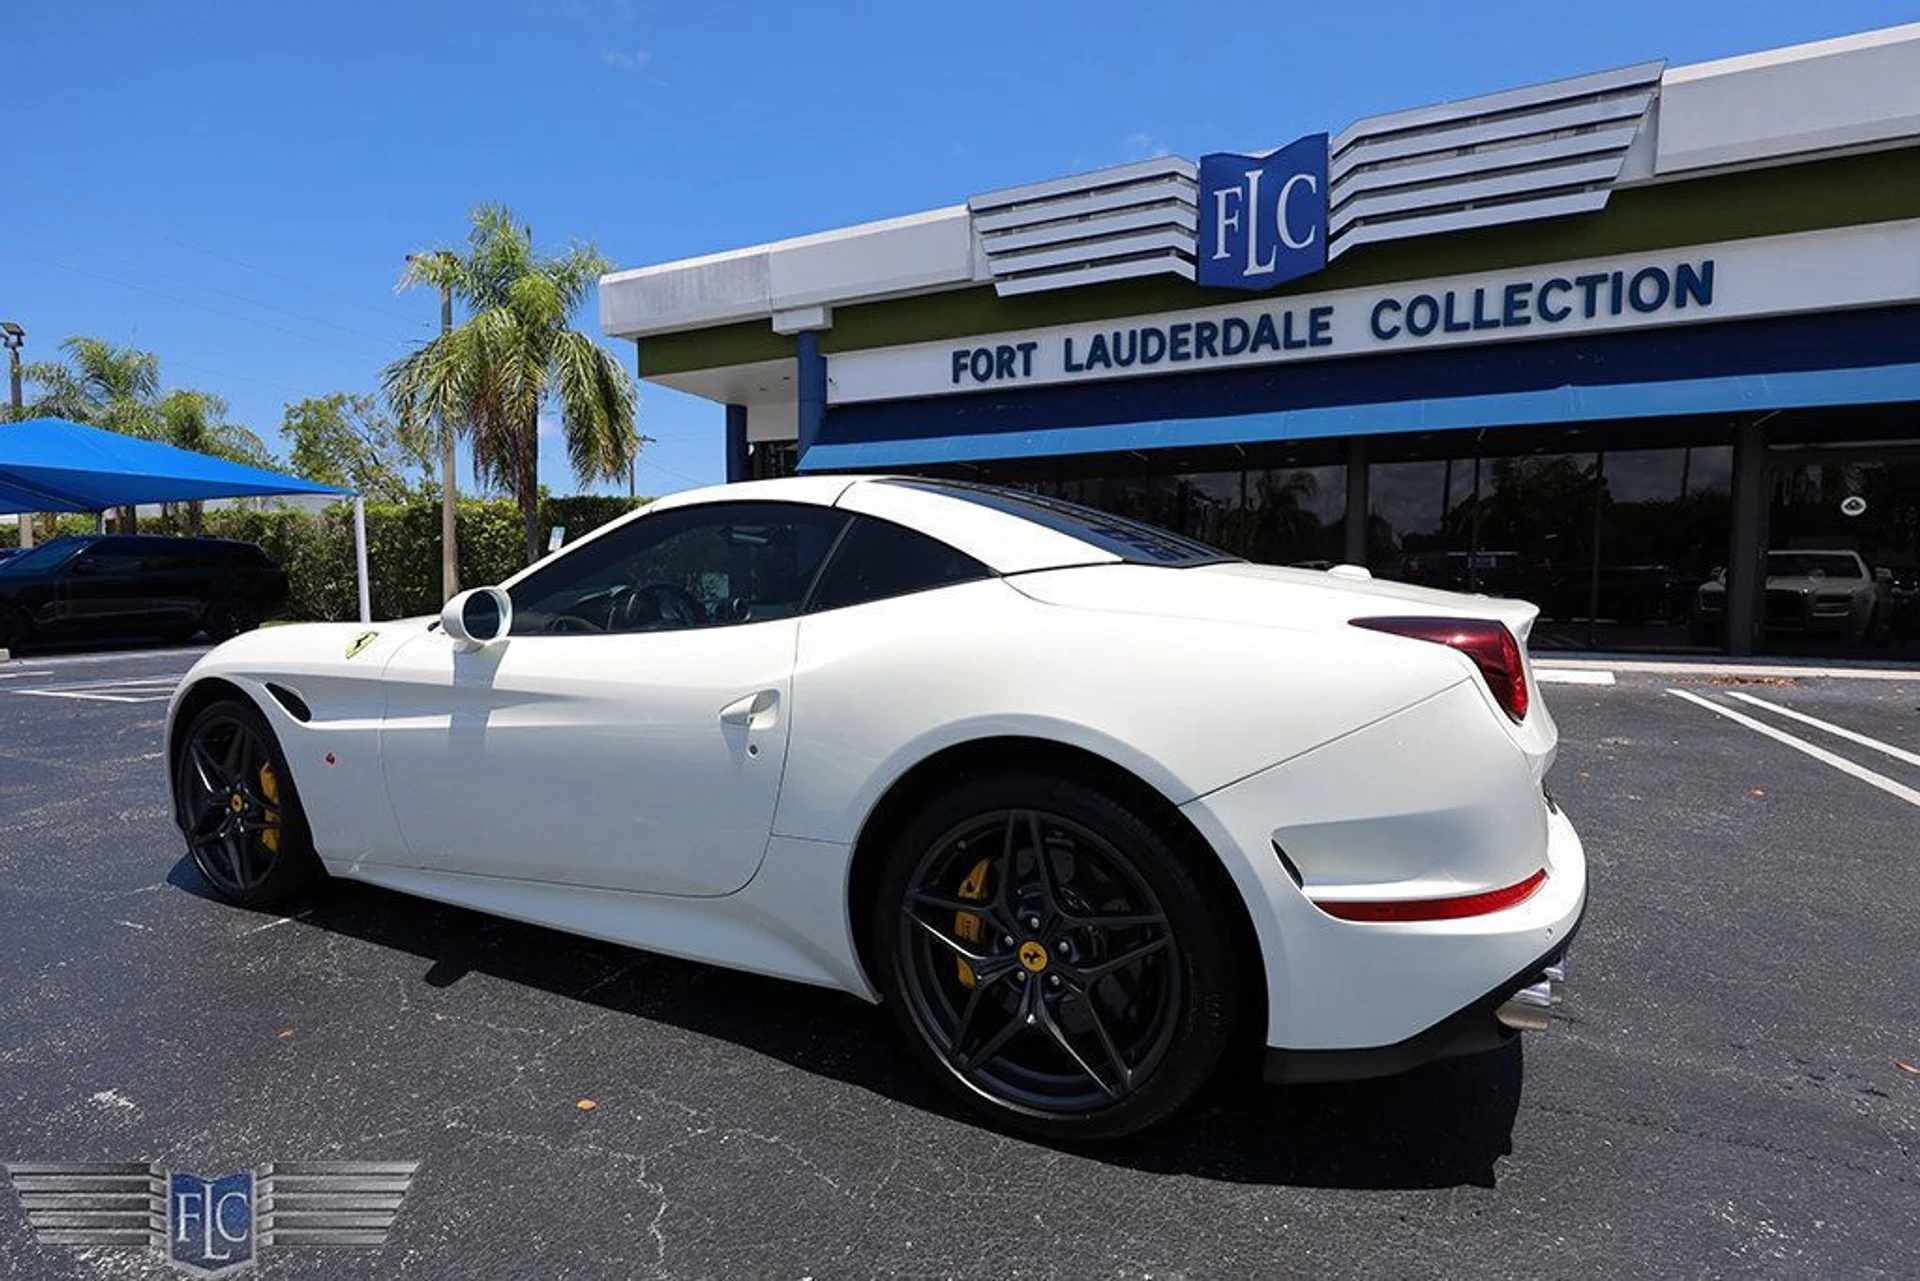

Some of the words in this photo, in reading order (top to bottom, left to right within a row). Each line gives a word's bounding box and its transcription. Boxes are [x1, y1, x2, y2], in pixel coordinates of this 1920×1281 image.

[1212, 169, 1317, 276] FLC
[951, 341, 1038, 384] FORT
[1063, 306, 1335, 374] LAUDERDALE
[1370, 260, 1715, 342] COLLECTION
